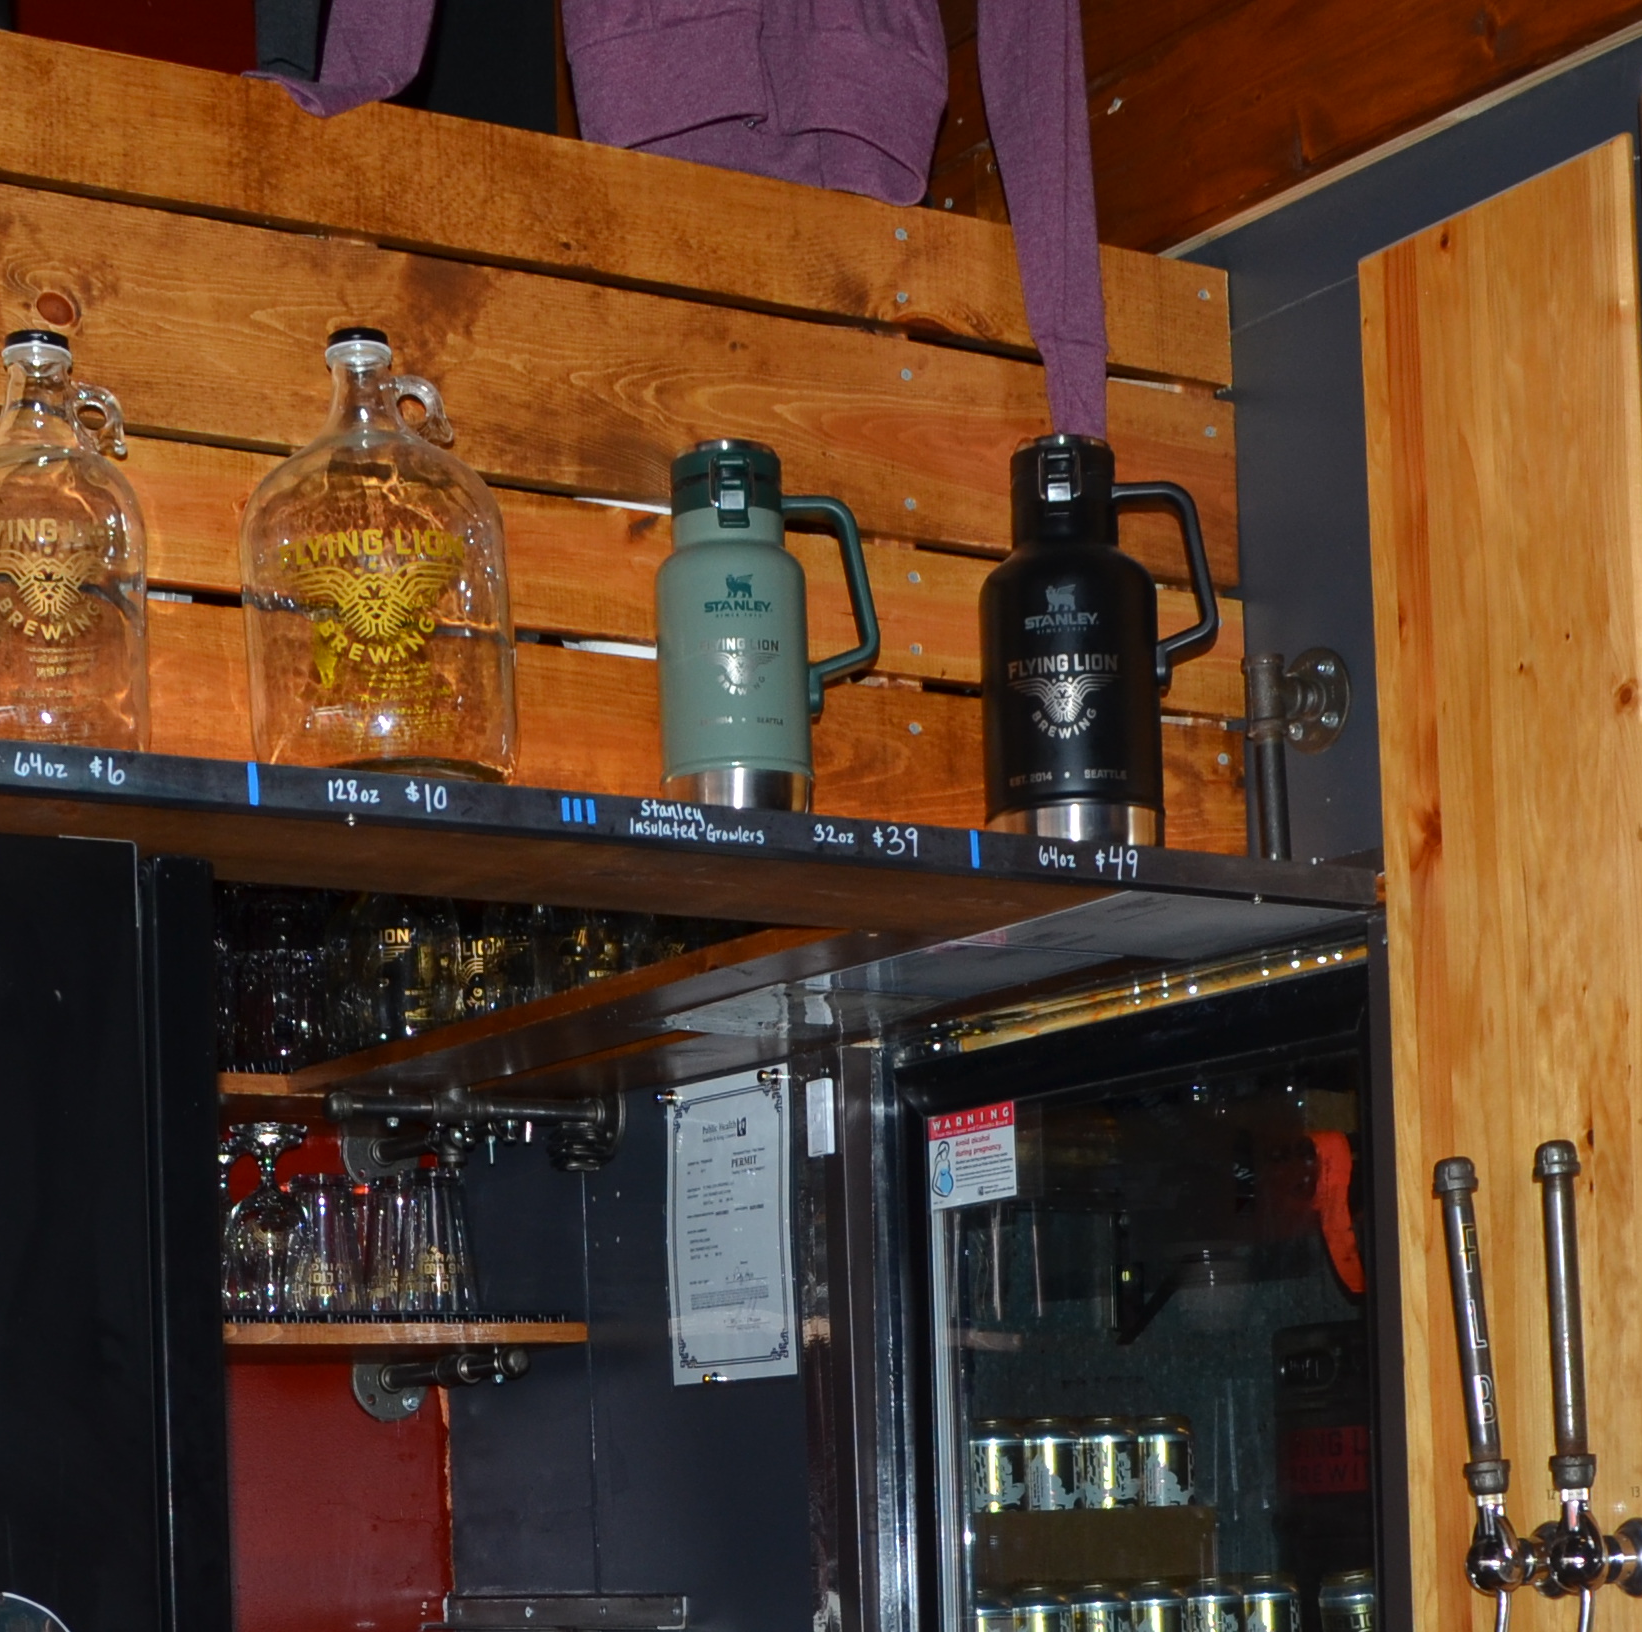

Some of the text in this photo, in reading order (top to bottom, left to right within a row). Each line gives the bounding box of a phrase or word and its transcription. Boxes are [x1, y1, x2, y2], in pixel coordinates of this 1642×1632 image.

[280, 527, 463, 570] FLYING LION
[319, 617, 435, 664] BREWING
[1008, 654, 1119, 679] FLYING LION
[1032, 707, 1097, 739] BREWING
[13, 752, 125, 785] 64oz $6
[1030, 772, 1053, 782] 2014
[1084, 769, 1127, 780] SEATTLE
[328, 781, 448, 811] 128oz $10
[641, 799, 706, 828] Stanley
[628, 819, 766, 845] Insulated Growlers
[813, 824, 919, 858] 32oz $39
[1038, 845, 1139, 878] 64oz $49
[933, 1106, 1009, 1131] WARNING
[731, 1155, 757, 1168] PERMIT
